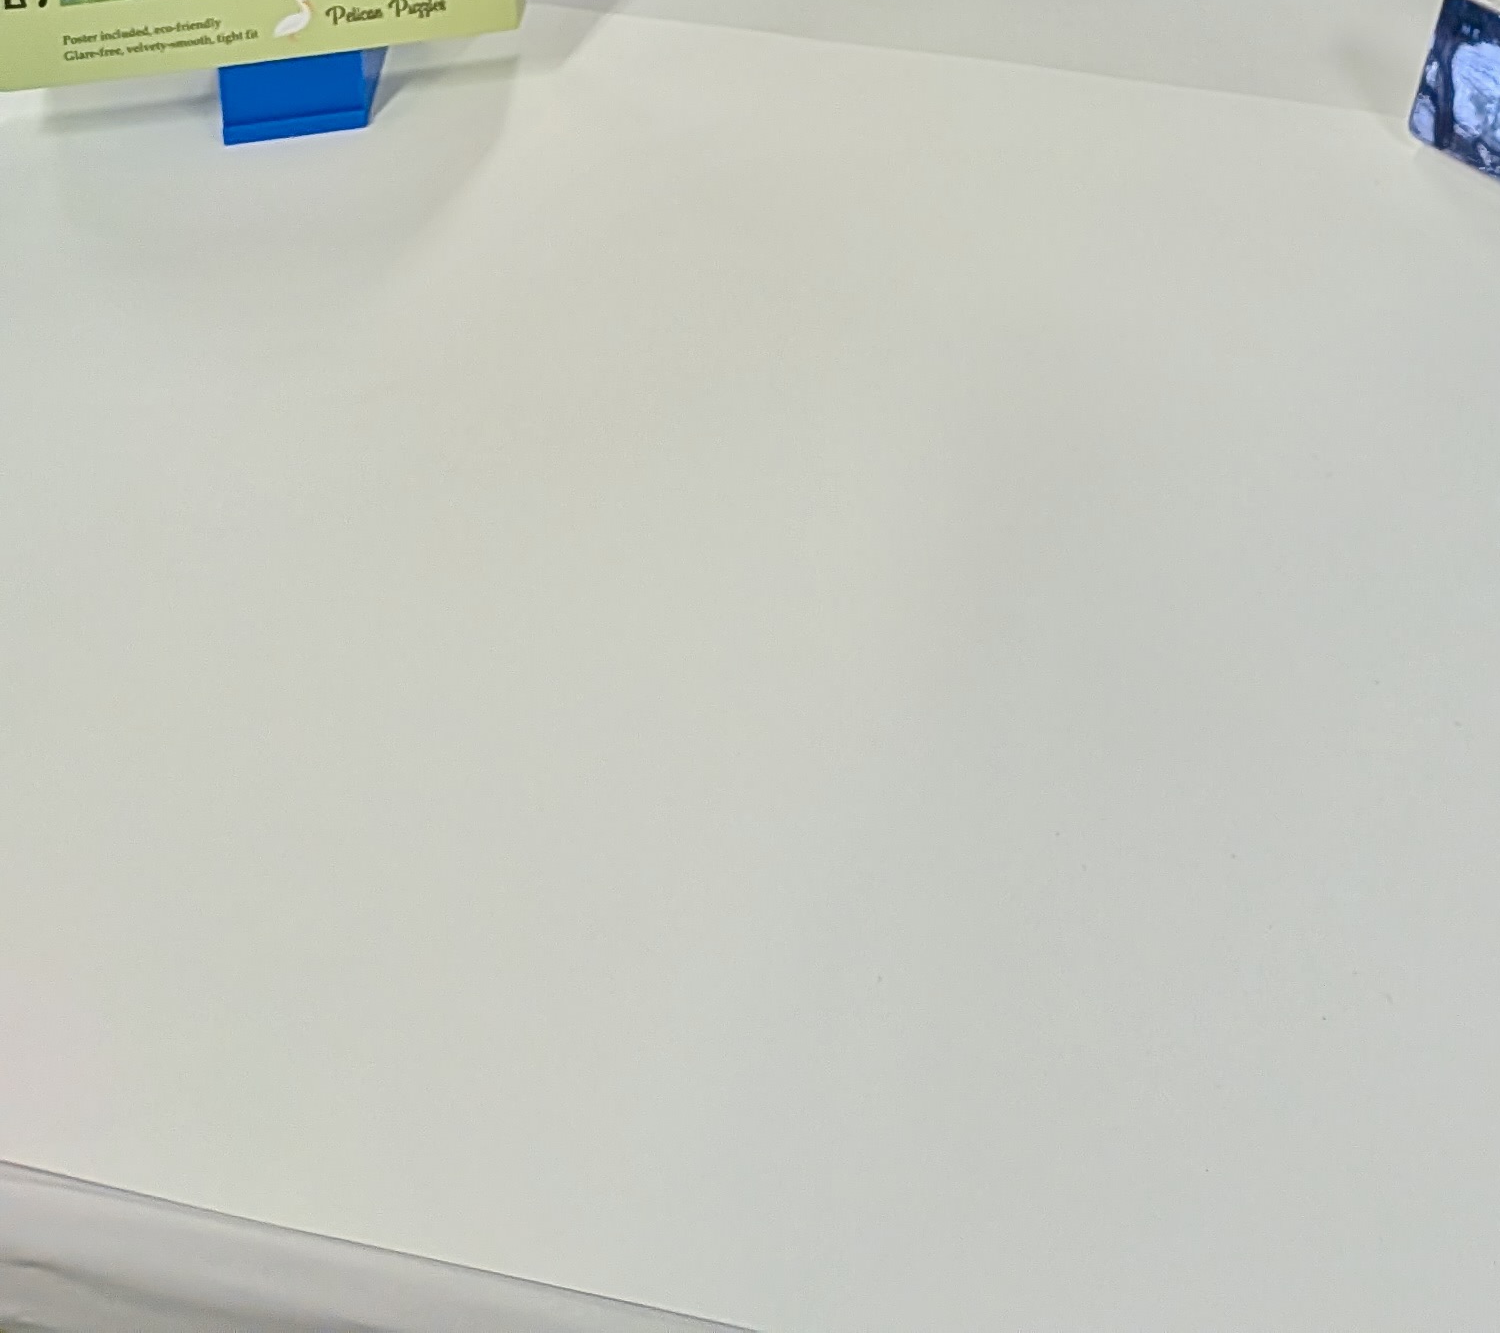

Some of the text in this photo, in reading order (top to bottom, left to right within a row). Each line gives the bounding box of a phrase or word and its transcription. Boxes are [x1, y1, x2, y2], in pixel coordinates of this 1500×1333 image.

[325, 5, 383, 26] Pelican
[63, 34, 98, 46] Poster
[153, 17, 222, 35] eco-friendly
[216, 30, 243, 45] tight
